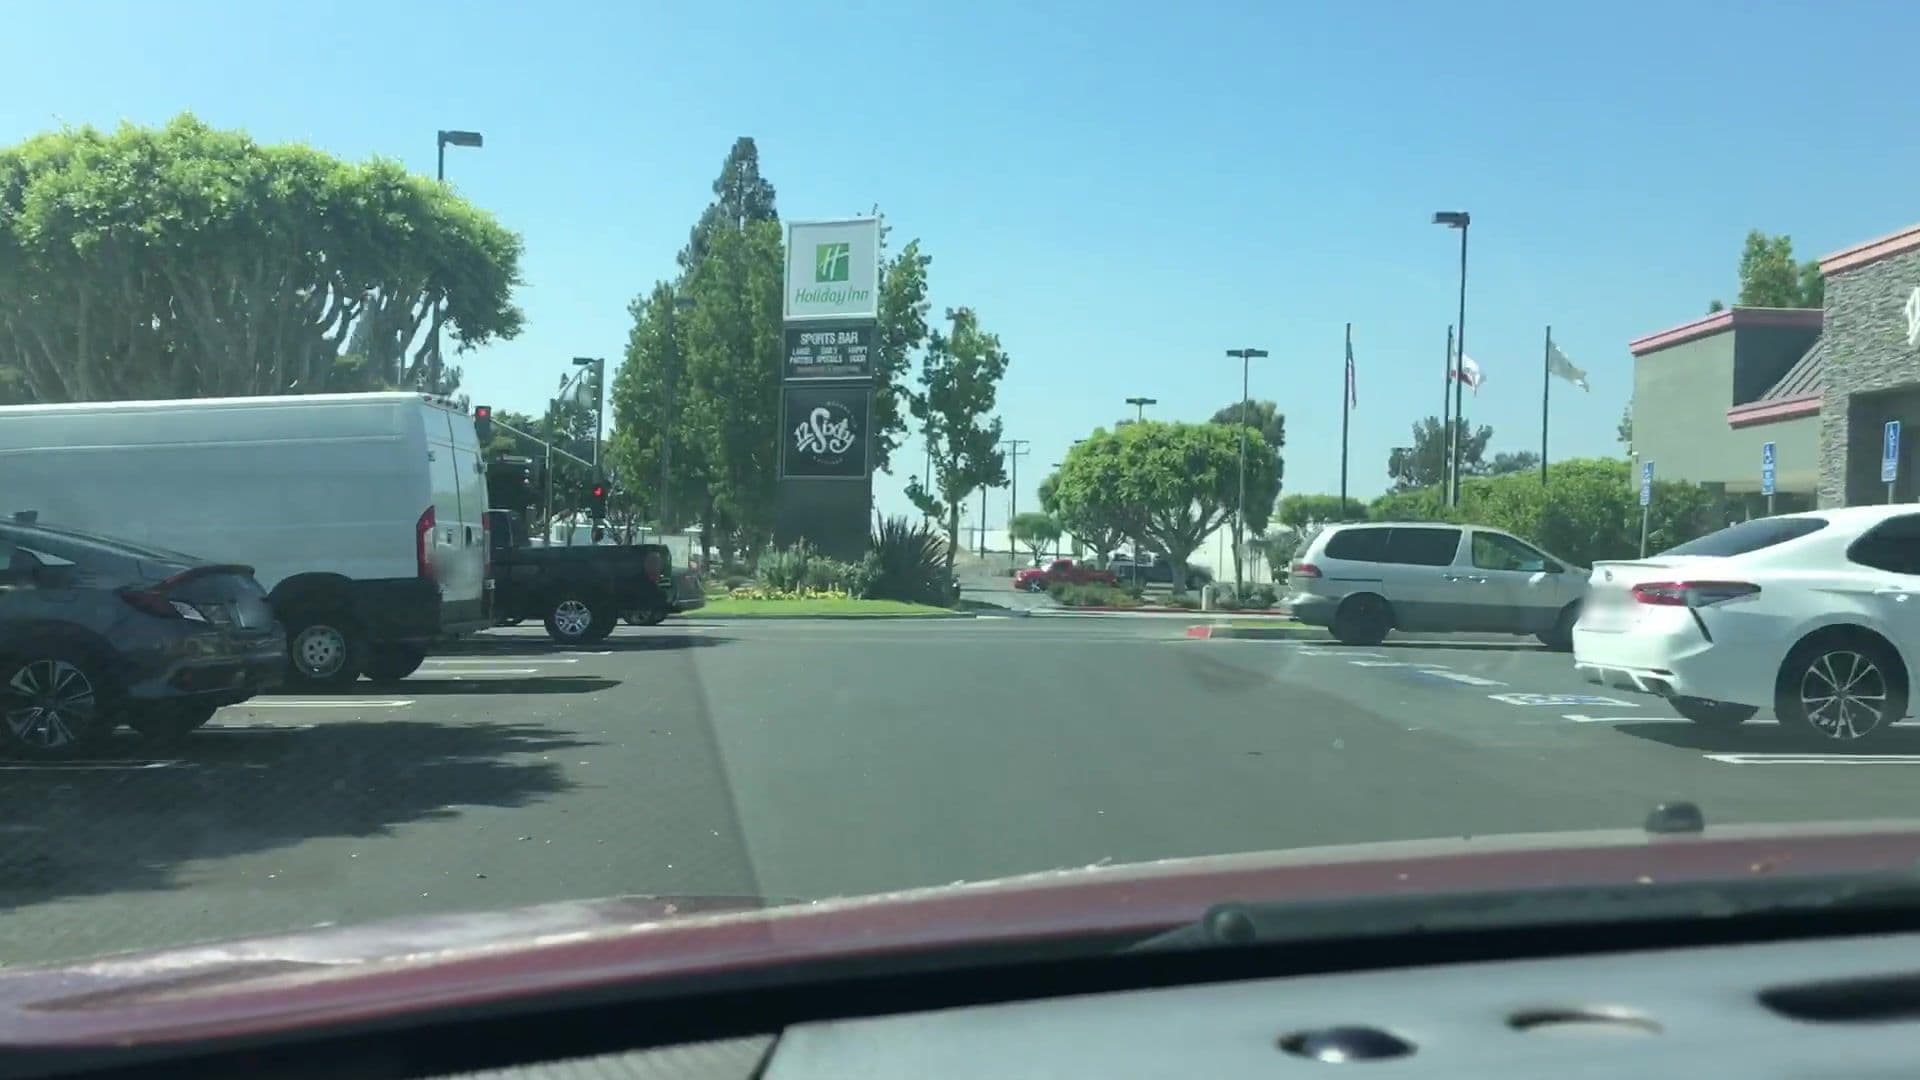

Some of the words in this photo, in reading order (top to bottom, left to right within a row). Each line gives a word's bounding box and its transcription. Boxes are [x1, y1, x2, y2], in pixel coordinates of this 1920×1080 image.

[795, 287, 846, 306] Holiday
[800, 332, 836, 345] SPORTS
[838, 332, 858, 344] BAR
